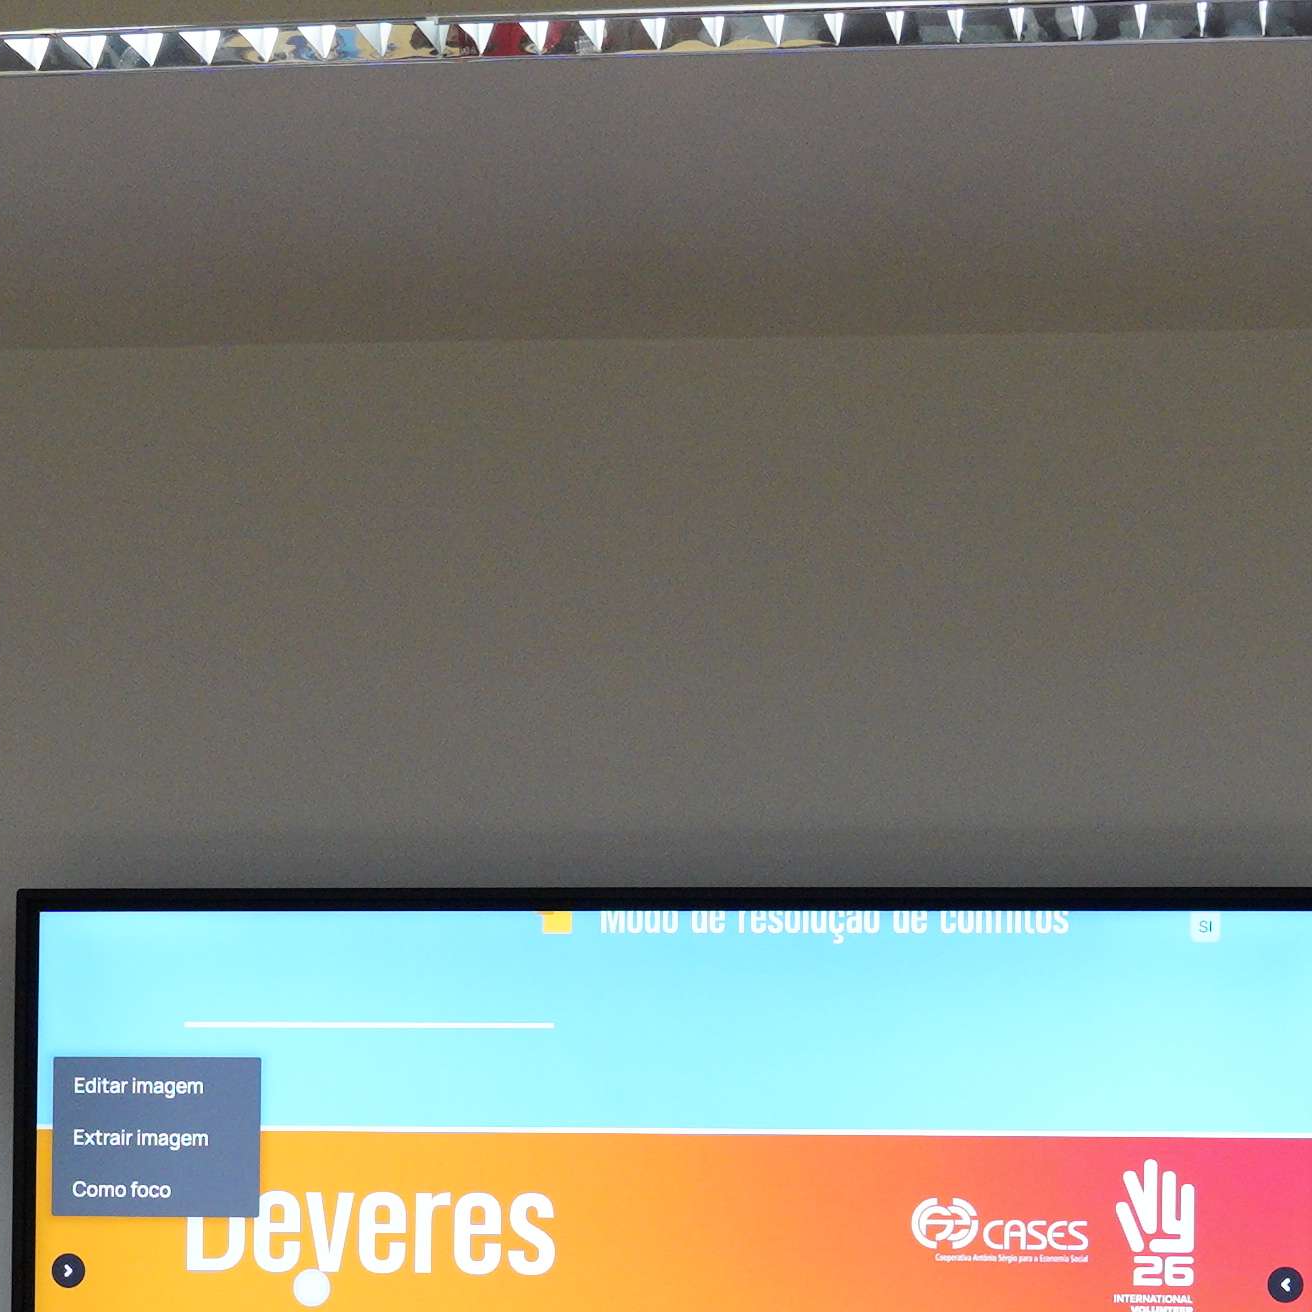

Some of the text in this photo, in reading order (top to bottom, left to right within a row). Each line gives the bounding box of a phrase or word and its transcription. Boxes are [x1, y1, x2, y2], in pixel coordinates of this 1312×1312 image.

[691, 911, 726, 934] de
[893, 911, 928, 934] de
[74, 1076, 204, 1099] Editar imagem
[73, 1128, 209, 1151] Extrair imagem
[72, 1180, 172, 1199] Como foco
[185, 1188, 556, 1277] Deveres
[983, 1219, 1089, 1251] CASES
[1132, 1255, 1195, 1287] 26
[1113, 1293, 1193, 1304] INTERNATIONAL
